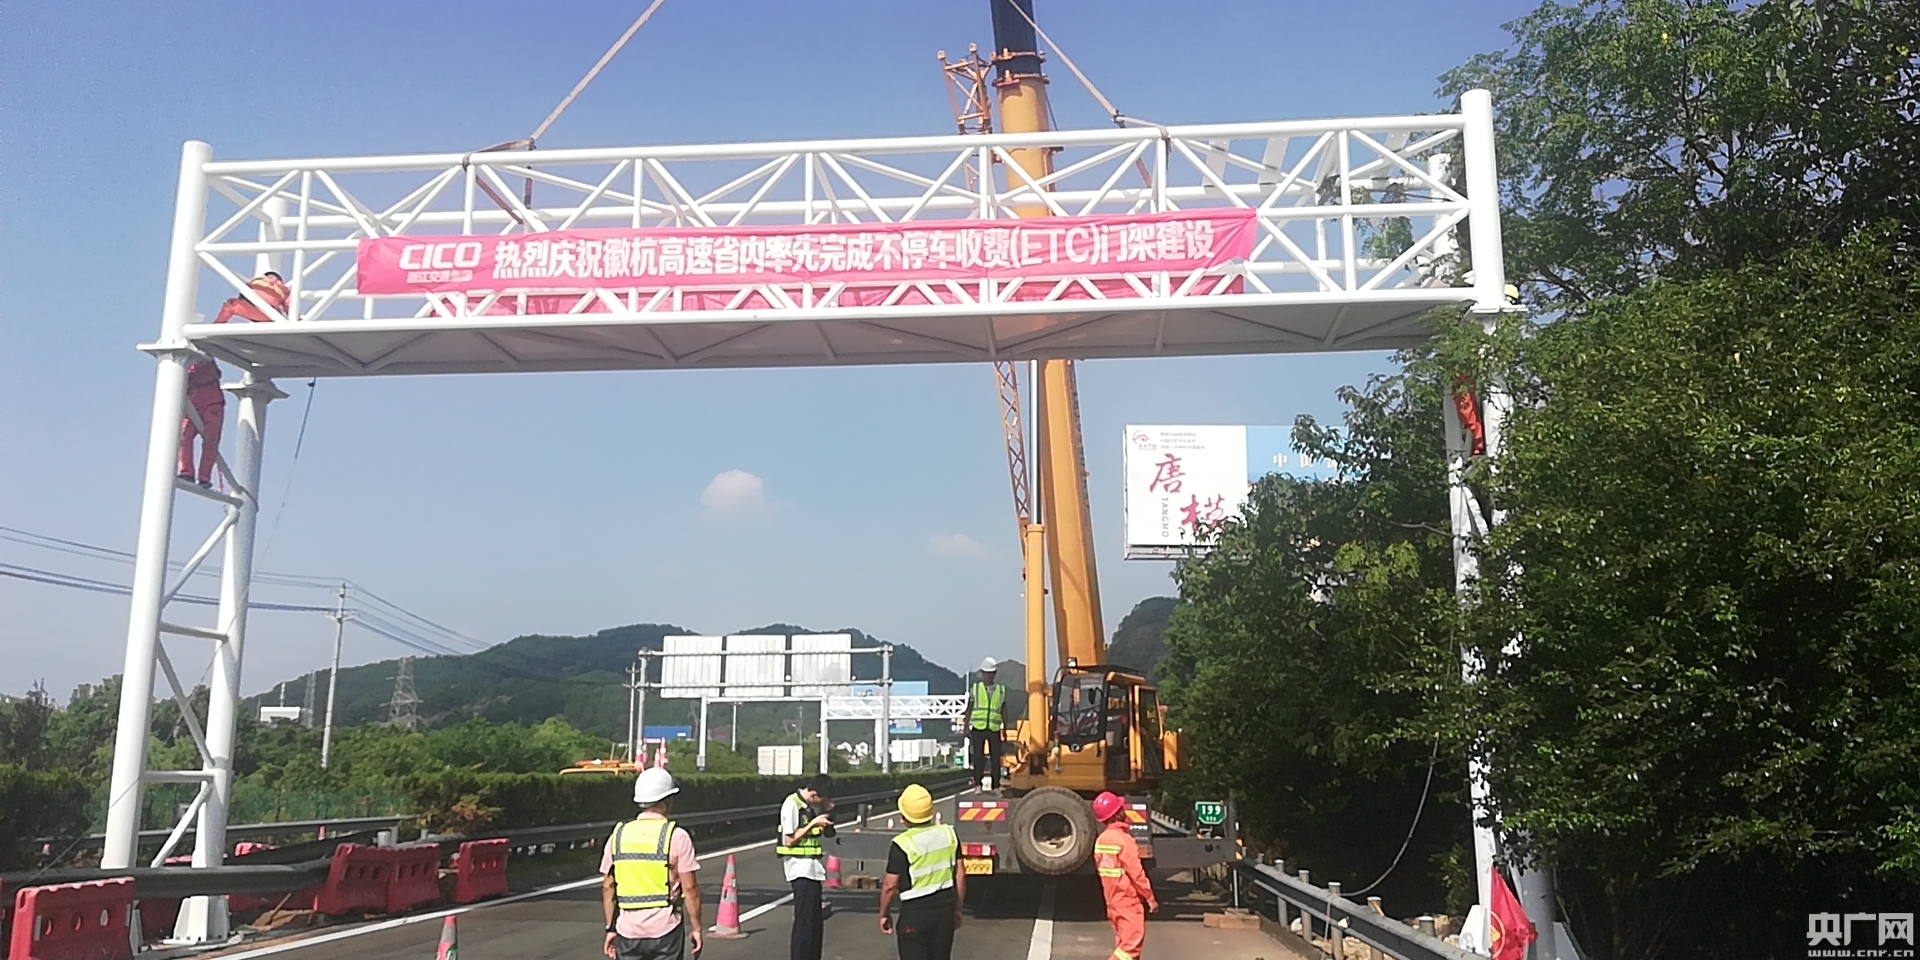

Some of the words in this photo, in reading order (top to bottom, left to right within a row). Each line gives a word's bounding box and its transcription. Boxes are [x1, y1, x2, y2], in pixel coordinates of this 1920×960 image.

[399, 242, 482, 270] CICO
[491, 220, 1216, 280] 热烈庆祝徽杭高速省内率先完成不停车收费(ETC)门架建设
[1161, 497, 1169, 538] TANGMO
[1201, 805, 1221, 816] 199
